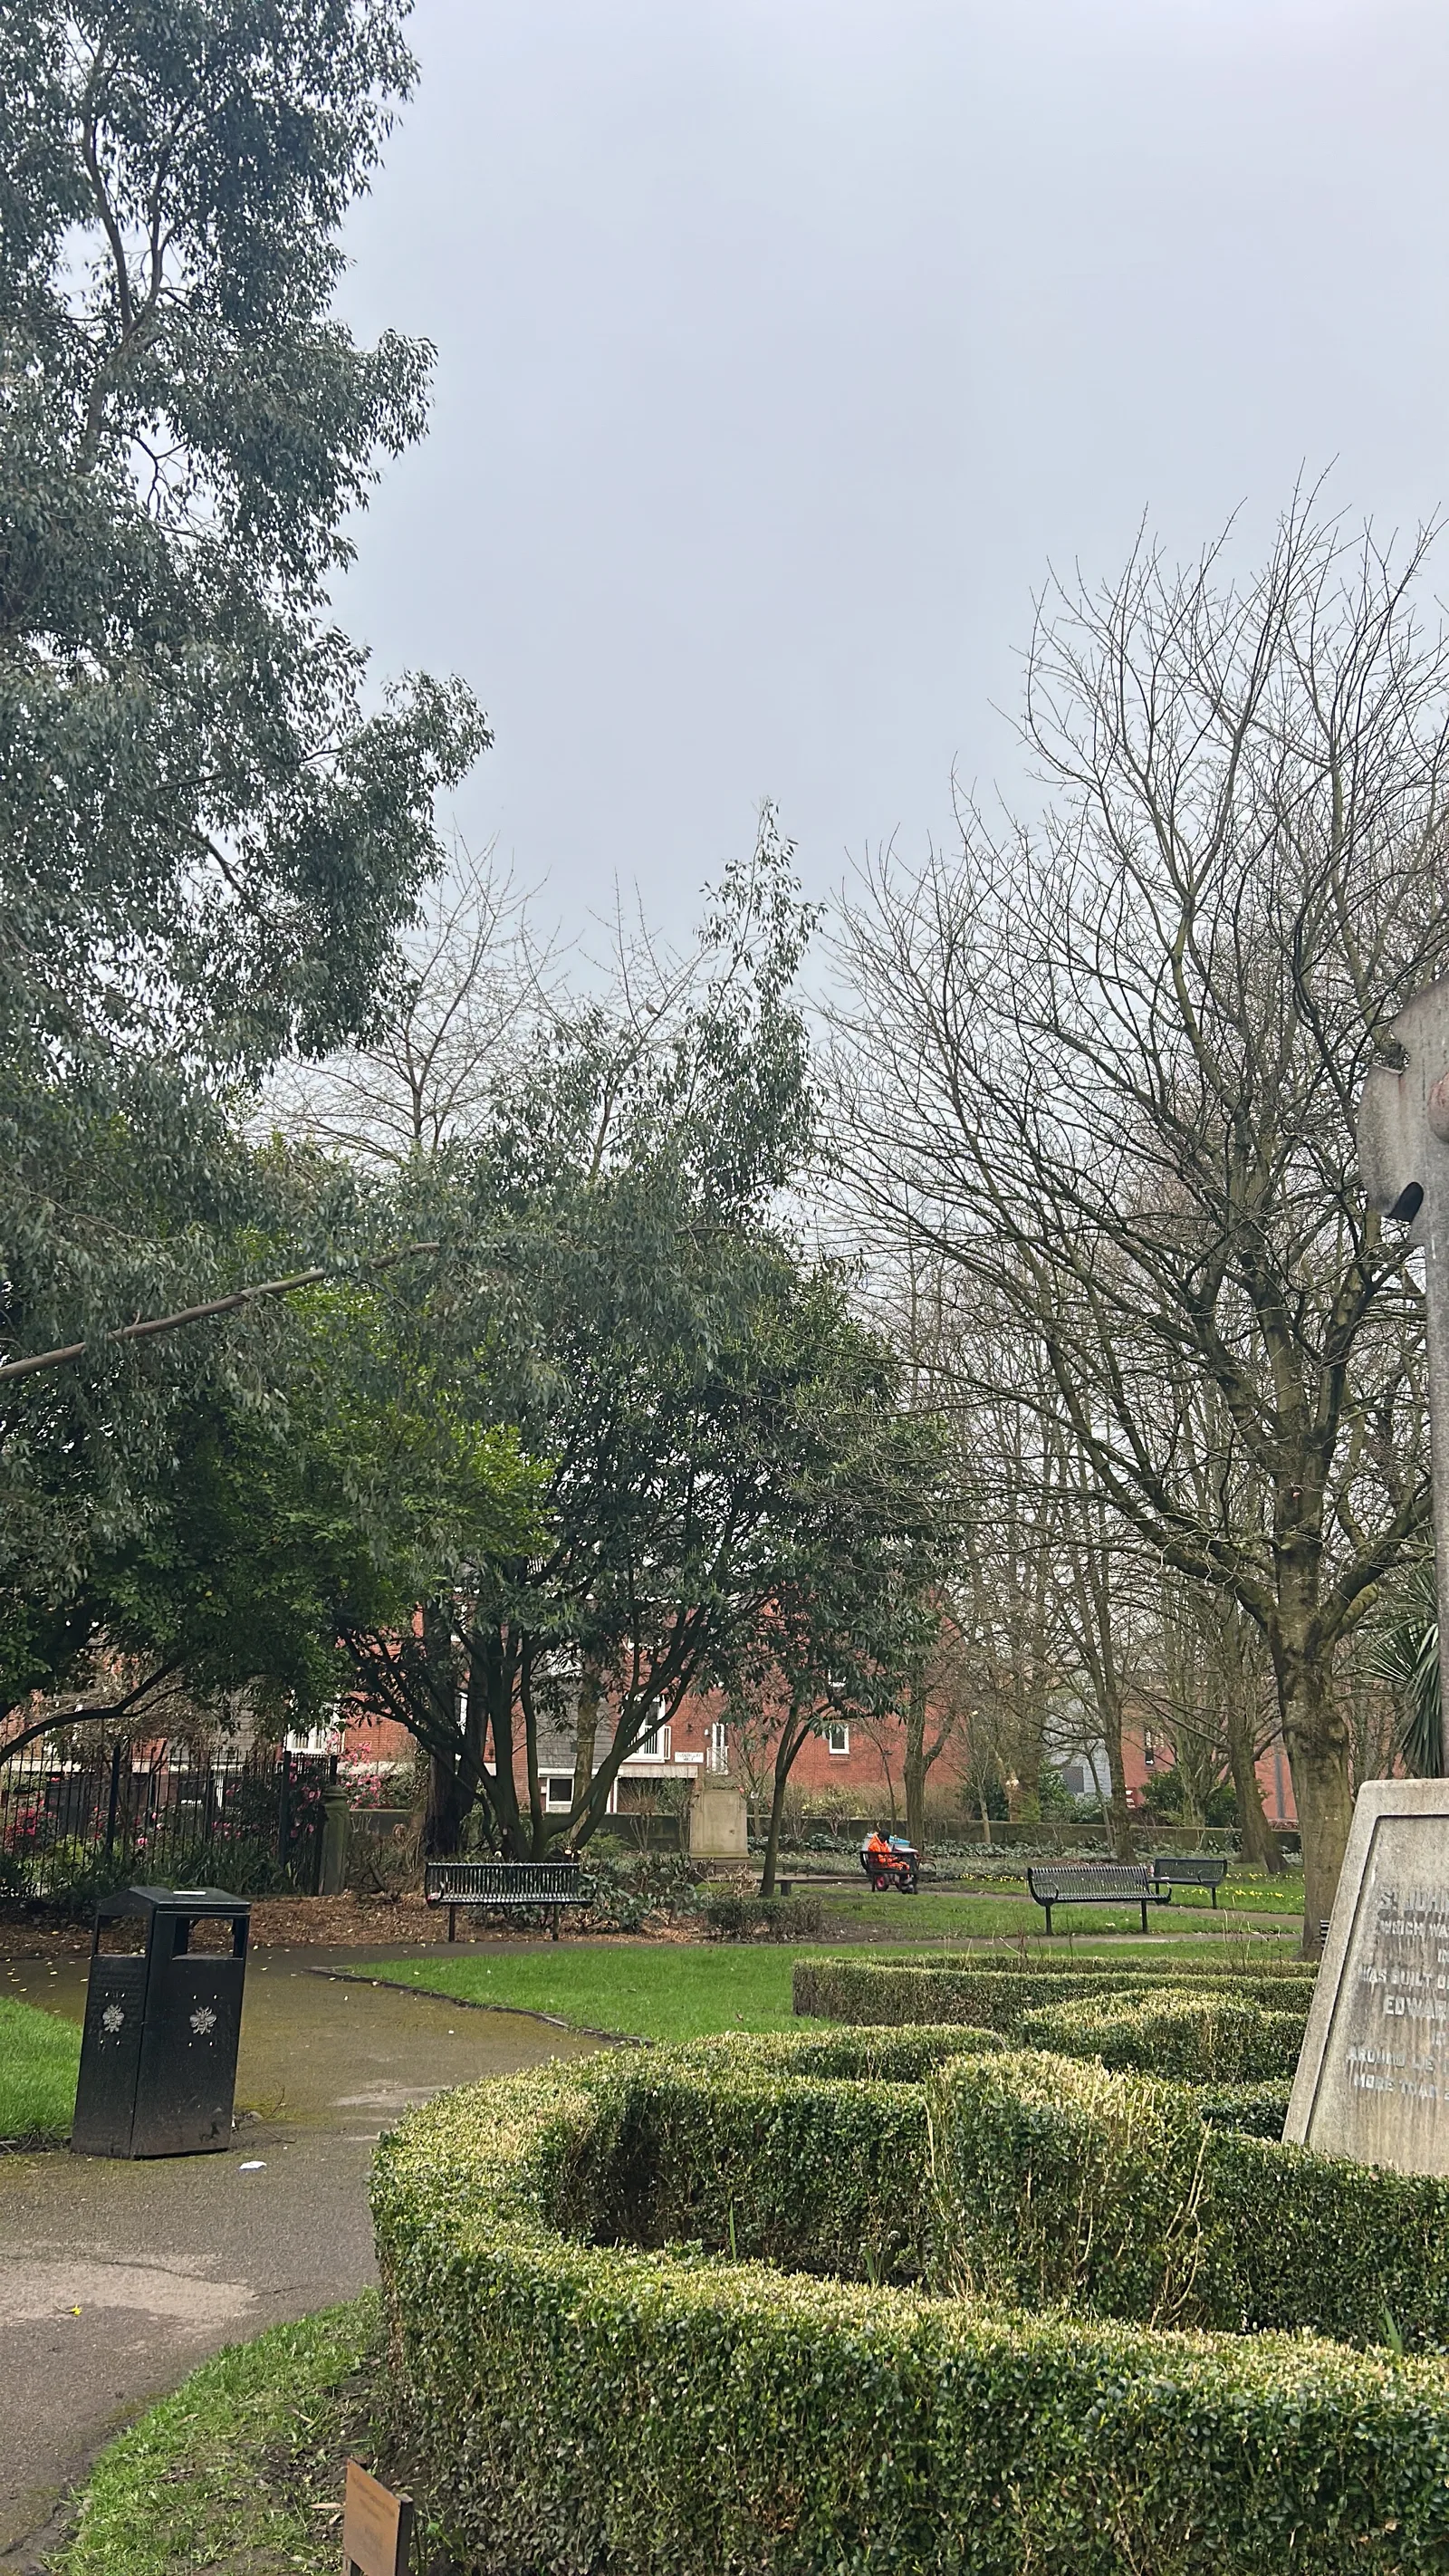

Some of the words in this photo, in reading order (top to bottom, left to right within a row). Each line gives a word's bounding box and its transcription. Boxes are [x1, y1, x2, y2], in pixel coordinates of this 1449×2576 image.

[1429, 1922, 1449, 1937] WA
[1391, 1967, 1433, 1988] BUILT
[1384, 1994, 1449, 2021] EDWAR
[1353, 2072, 1396, 2092] MORE
